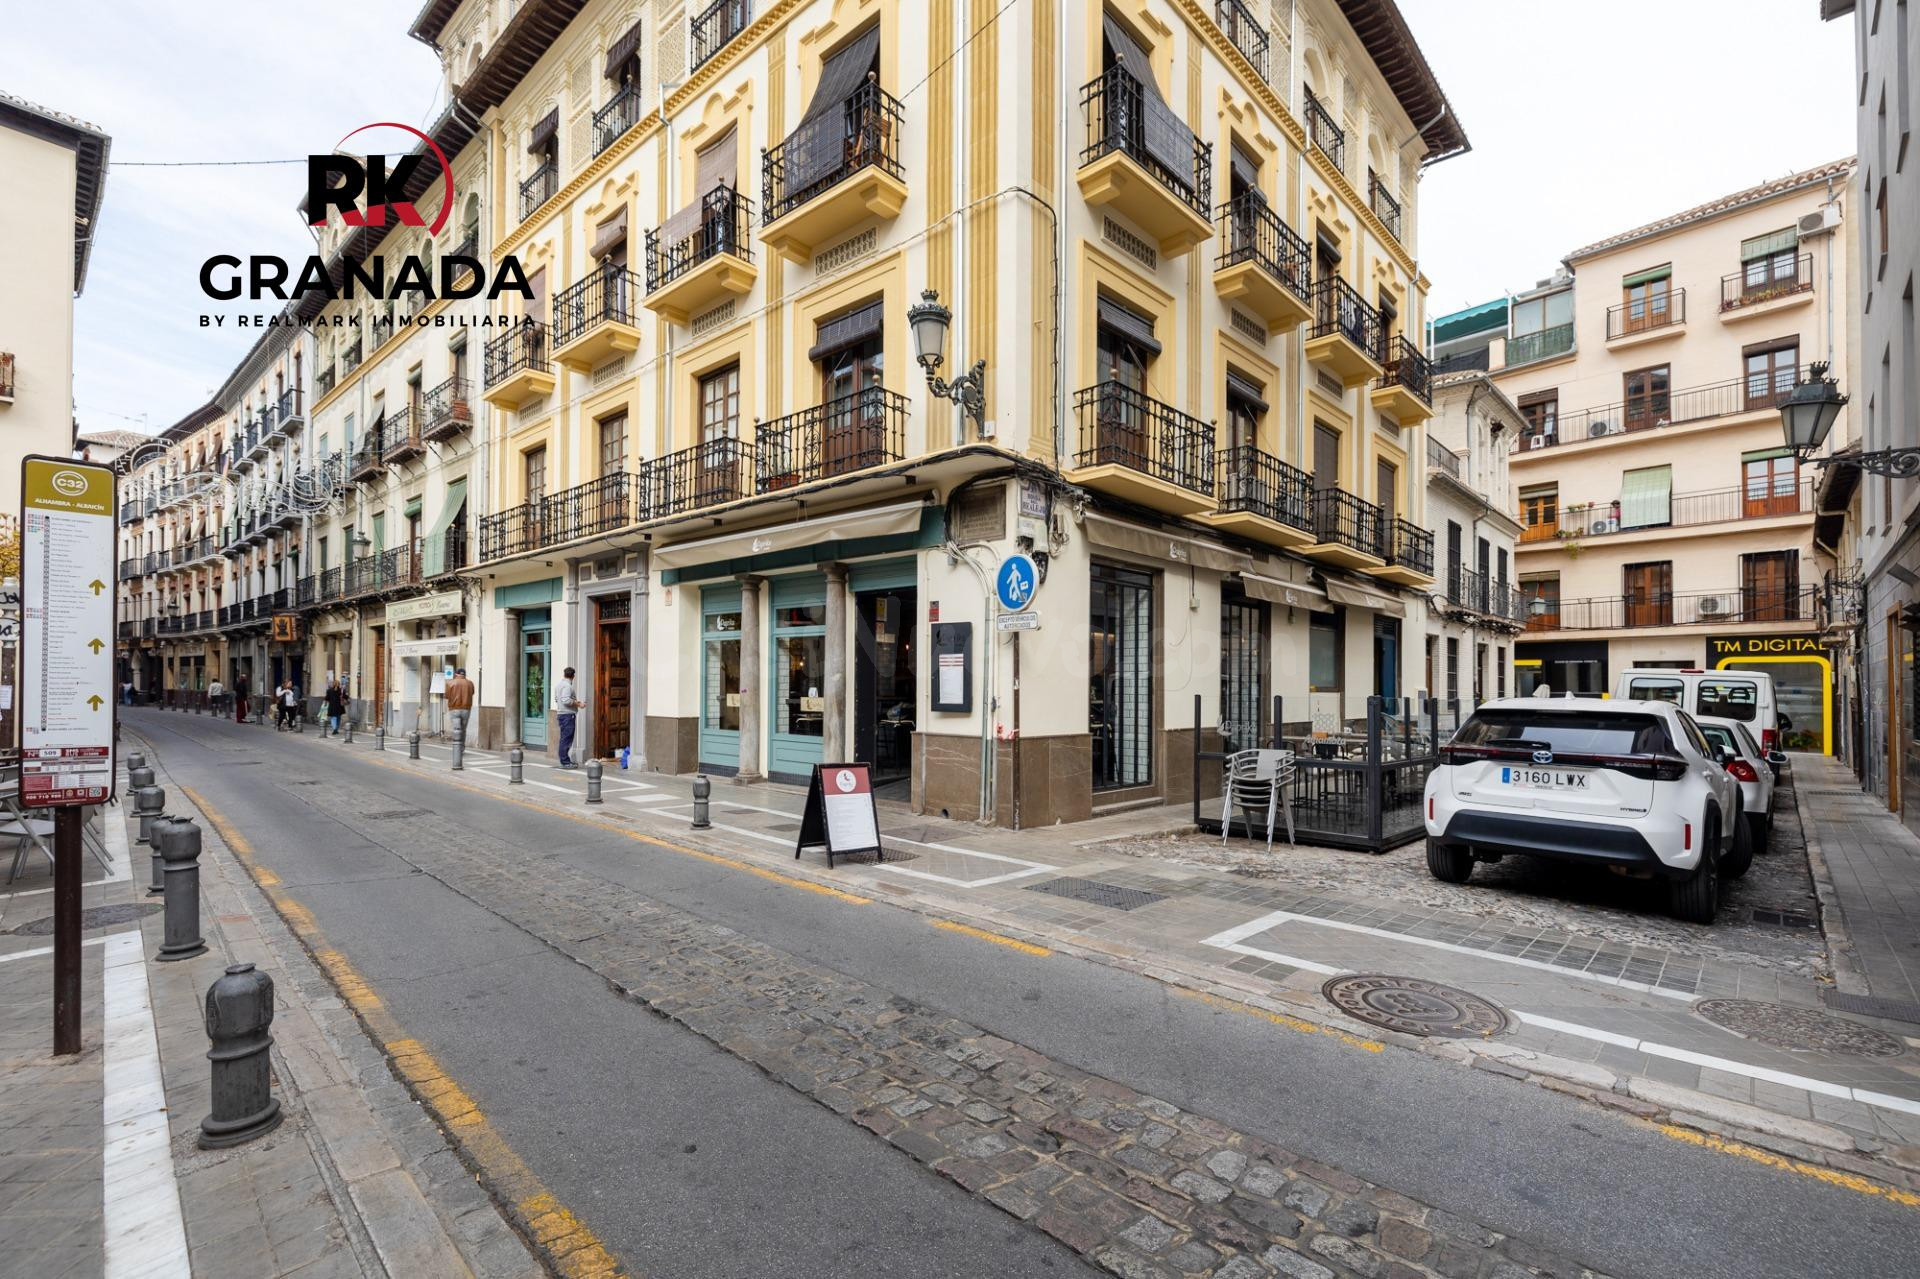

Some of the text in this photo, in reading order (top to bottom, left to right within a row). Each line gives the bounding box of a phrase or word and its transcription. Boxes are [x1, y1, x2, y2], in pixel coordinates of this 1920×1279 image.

[56, 478, 84, 489] C32
[34, 497, 71, 507] ALHAMBRA
[1713, 638, 1828, 652] TM DIGITAL
[1512, 769, 1586, 788] 3160 LWX
